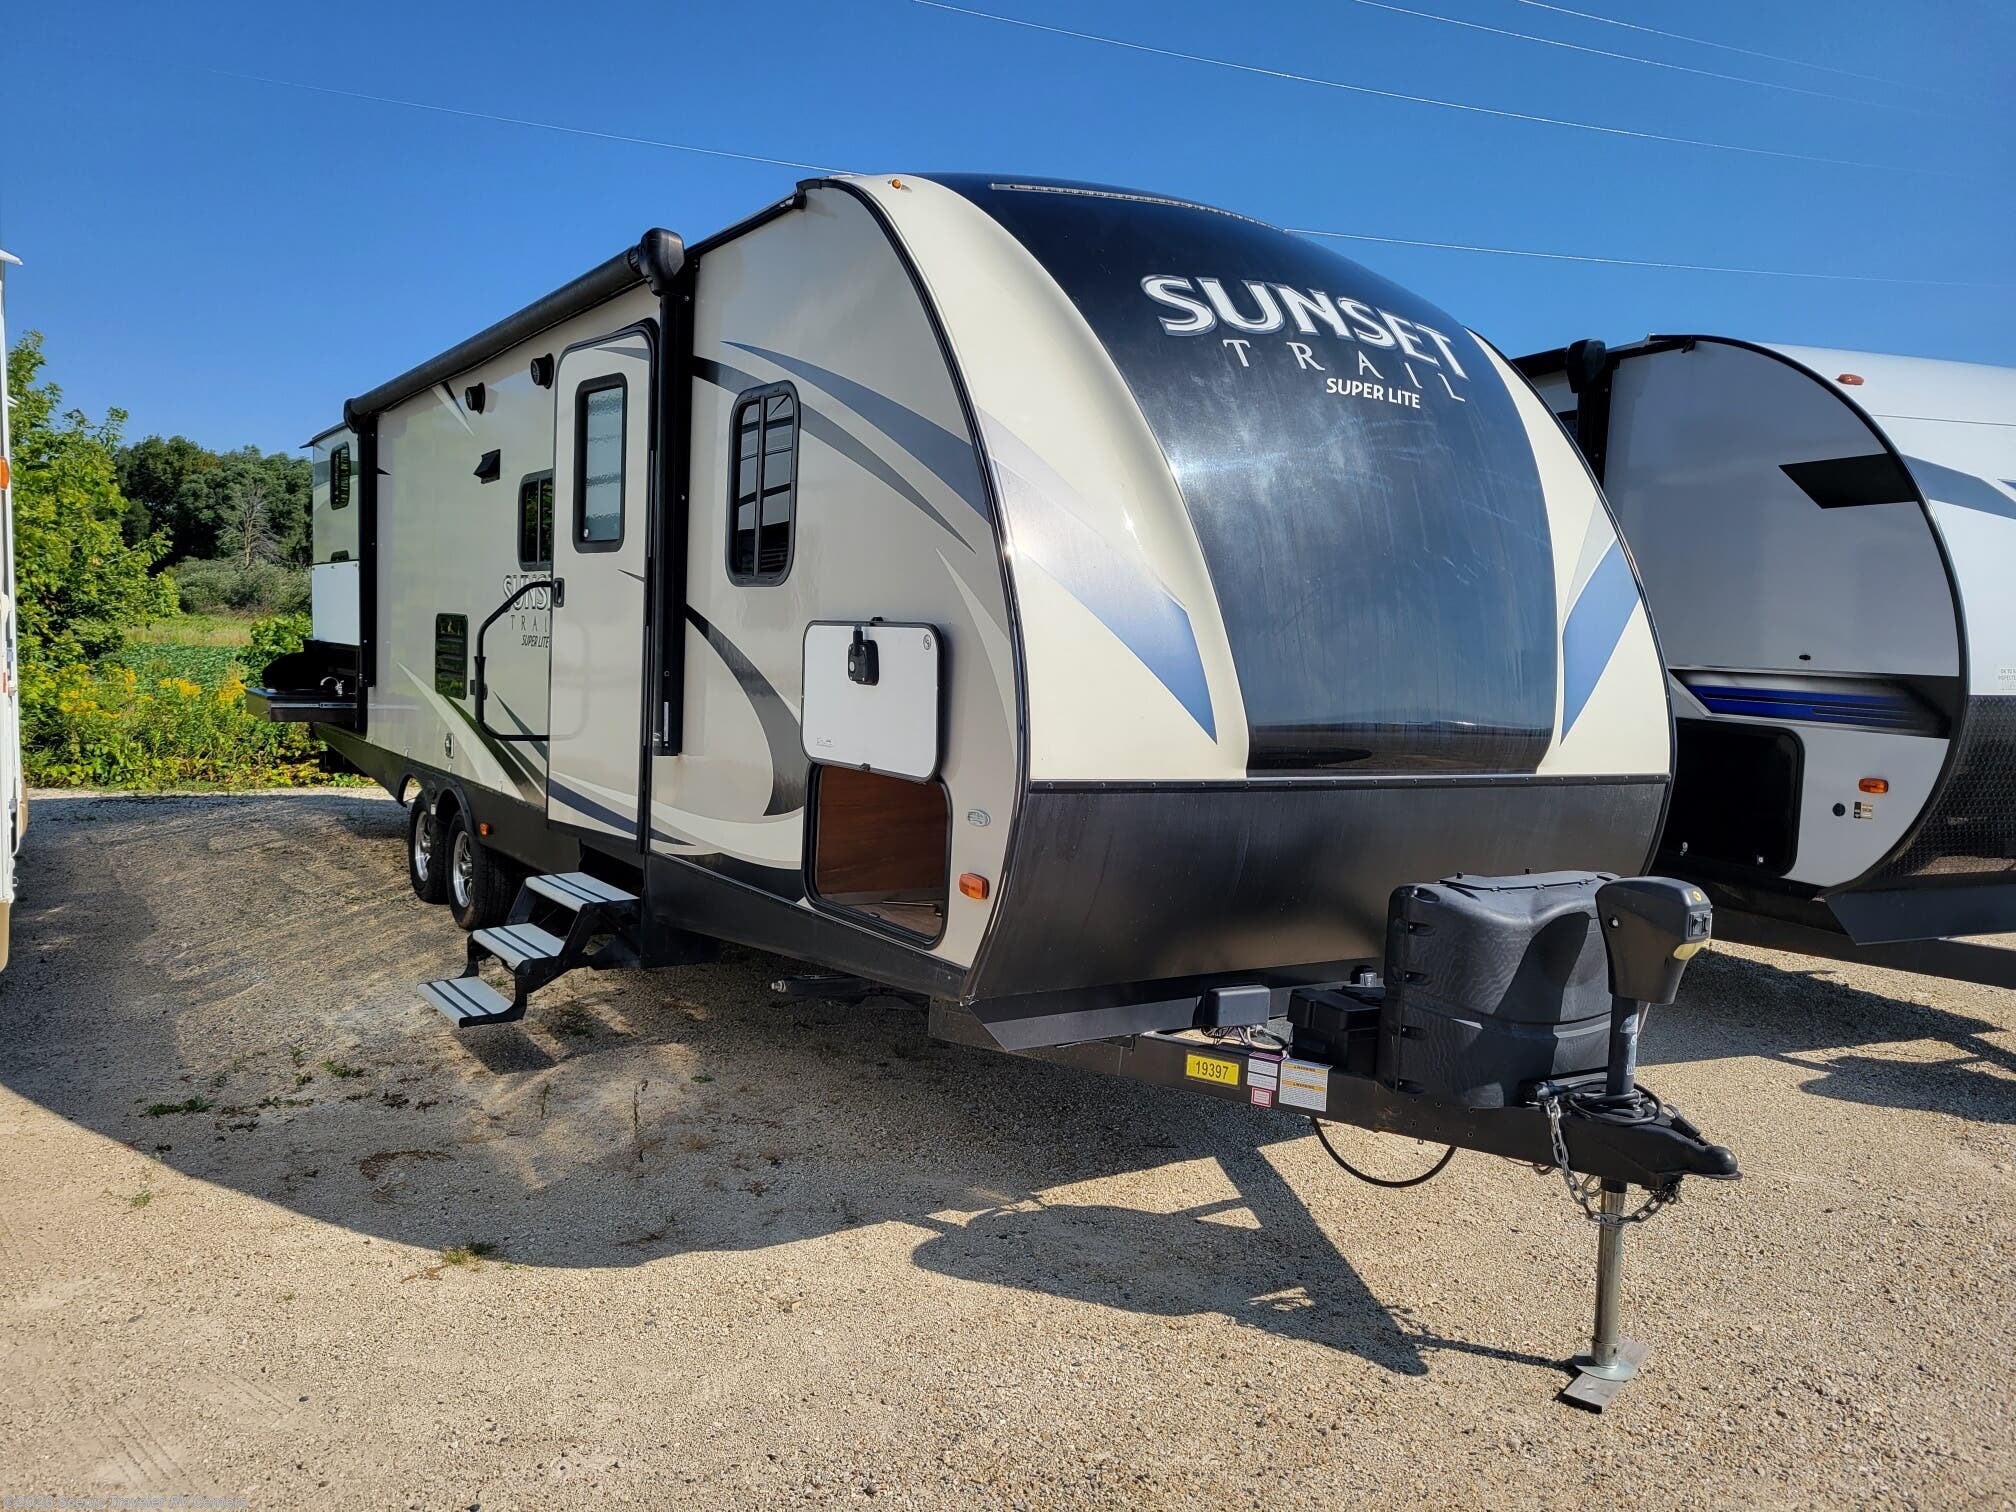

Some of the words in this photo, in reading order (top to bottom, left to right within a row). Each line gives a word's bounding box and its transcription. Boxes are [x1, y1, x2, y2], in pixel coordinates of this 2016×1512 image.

[1141, 275, 1471, 383] SUNSET
[1223, 339, 1466, 402] TRAIL
[1326, 378, 1385, 402] SUPER
[1388, 387, 1421, 409] LITE
[521, 634, 538, 647] SUPER
[1195, 1060, 1229, 1080] 19397
